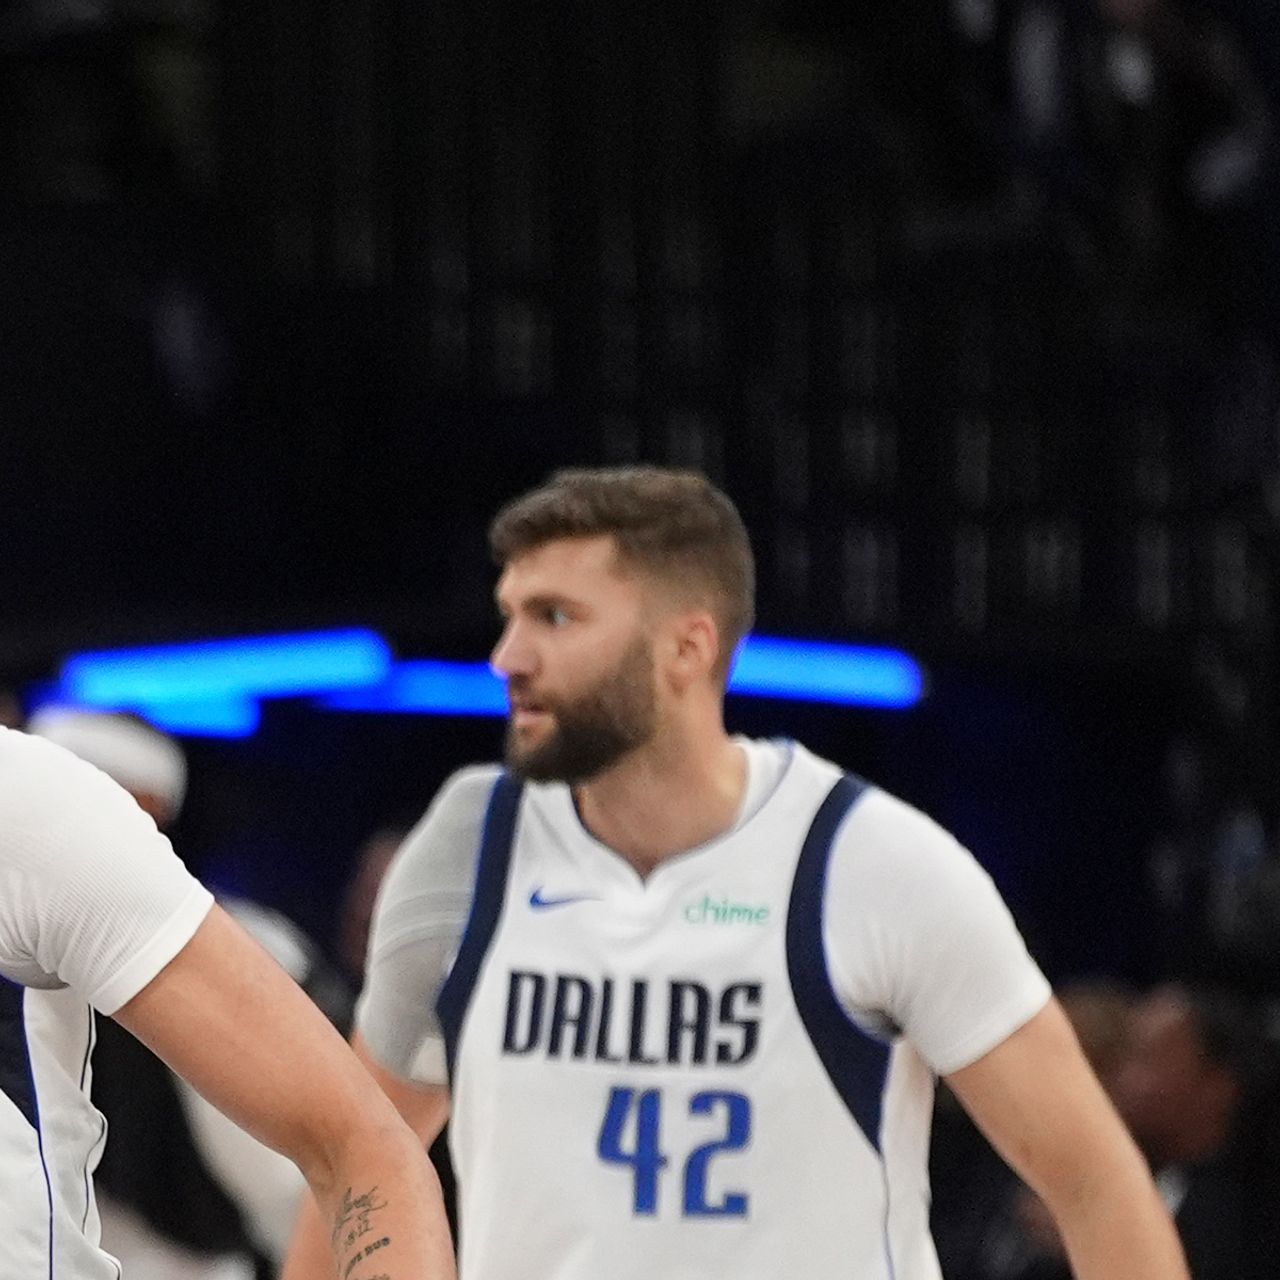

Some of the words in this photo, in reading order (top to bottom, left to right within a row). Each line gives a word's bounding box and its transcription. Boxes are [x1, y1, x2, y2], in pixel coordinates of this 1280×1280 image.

[683, 893, 771, 927] chime
[501, 970, 763, 1067] DALLAS
[597, 1085, 753, 1219] 42
